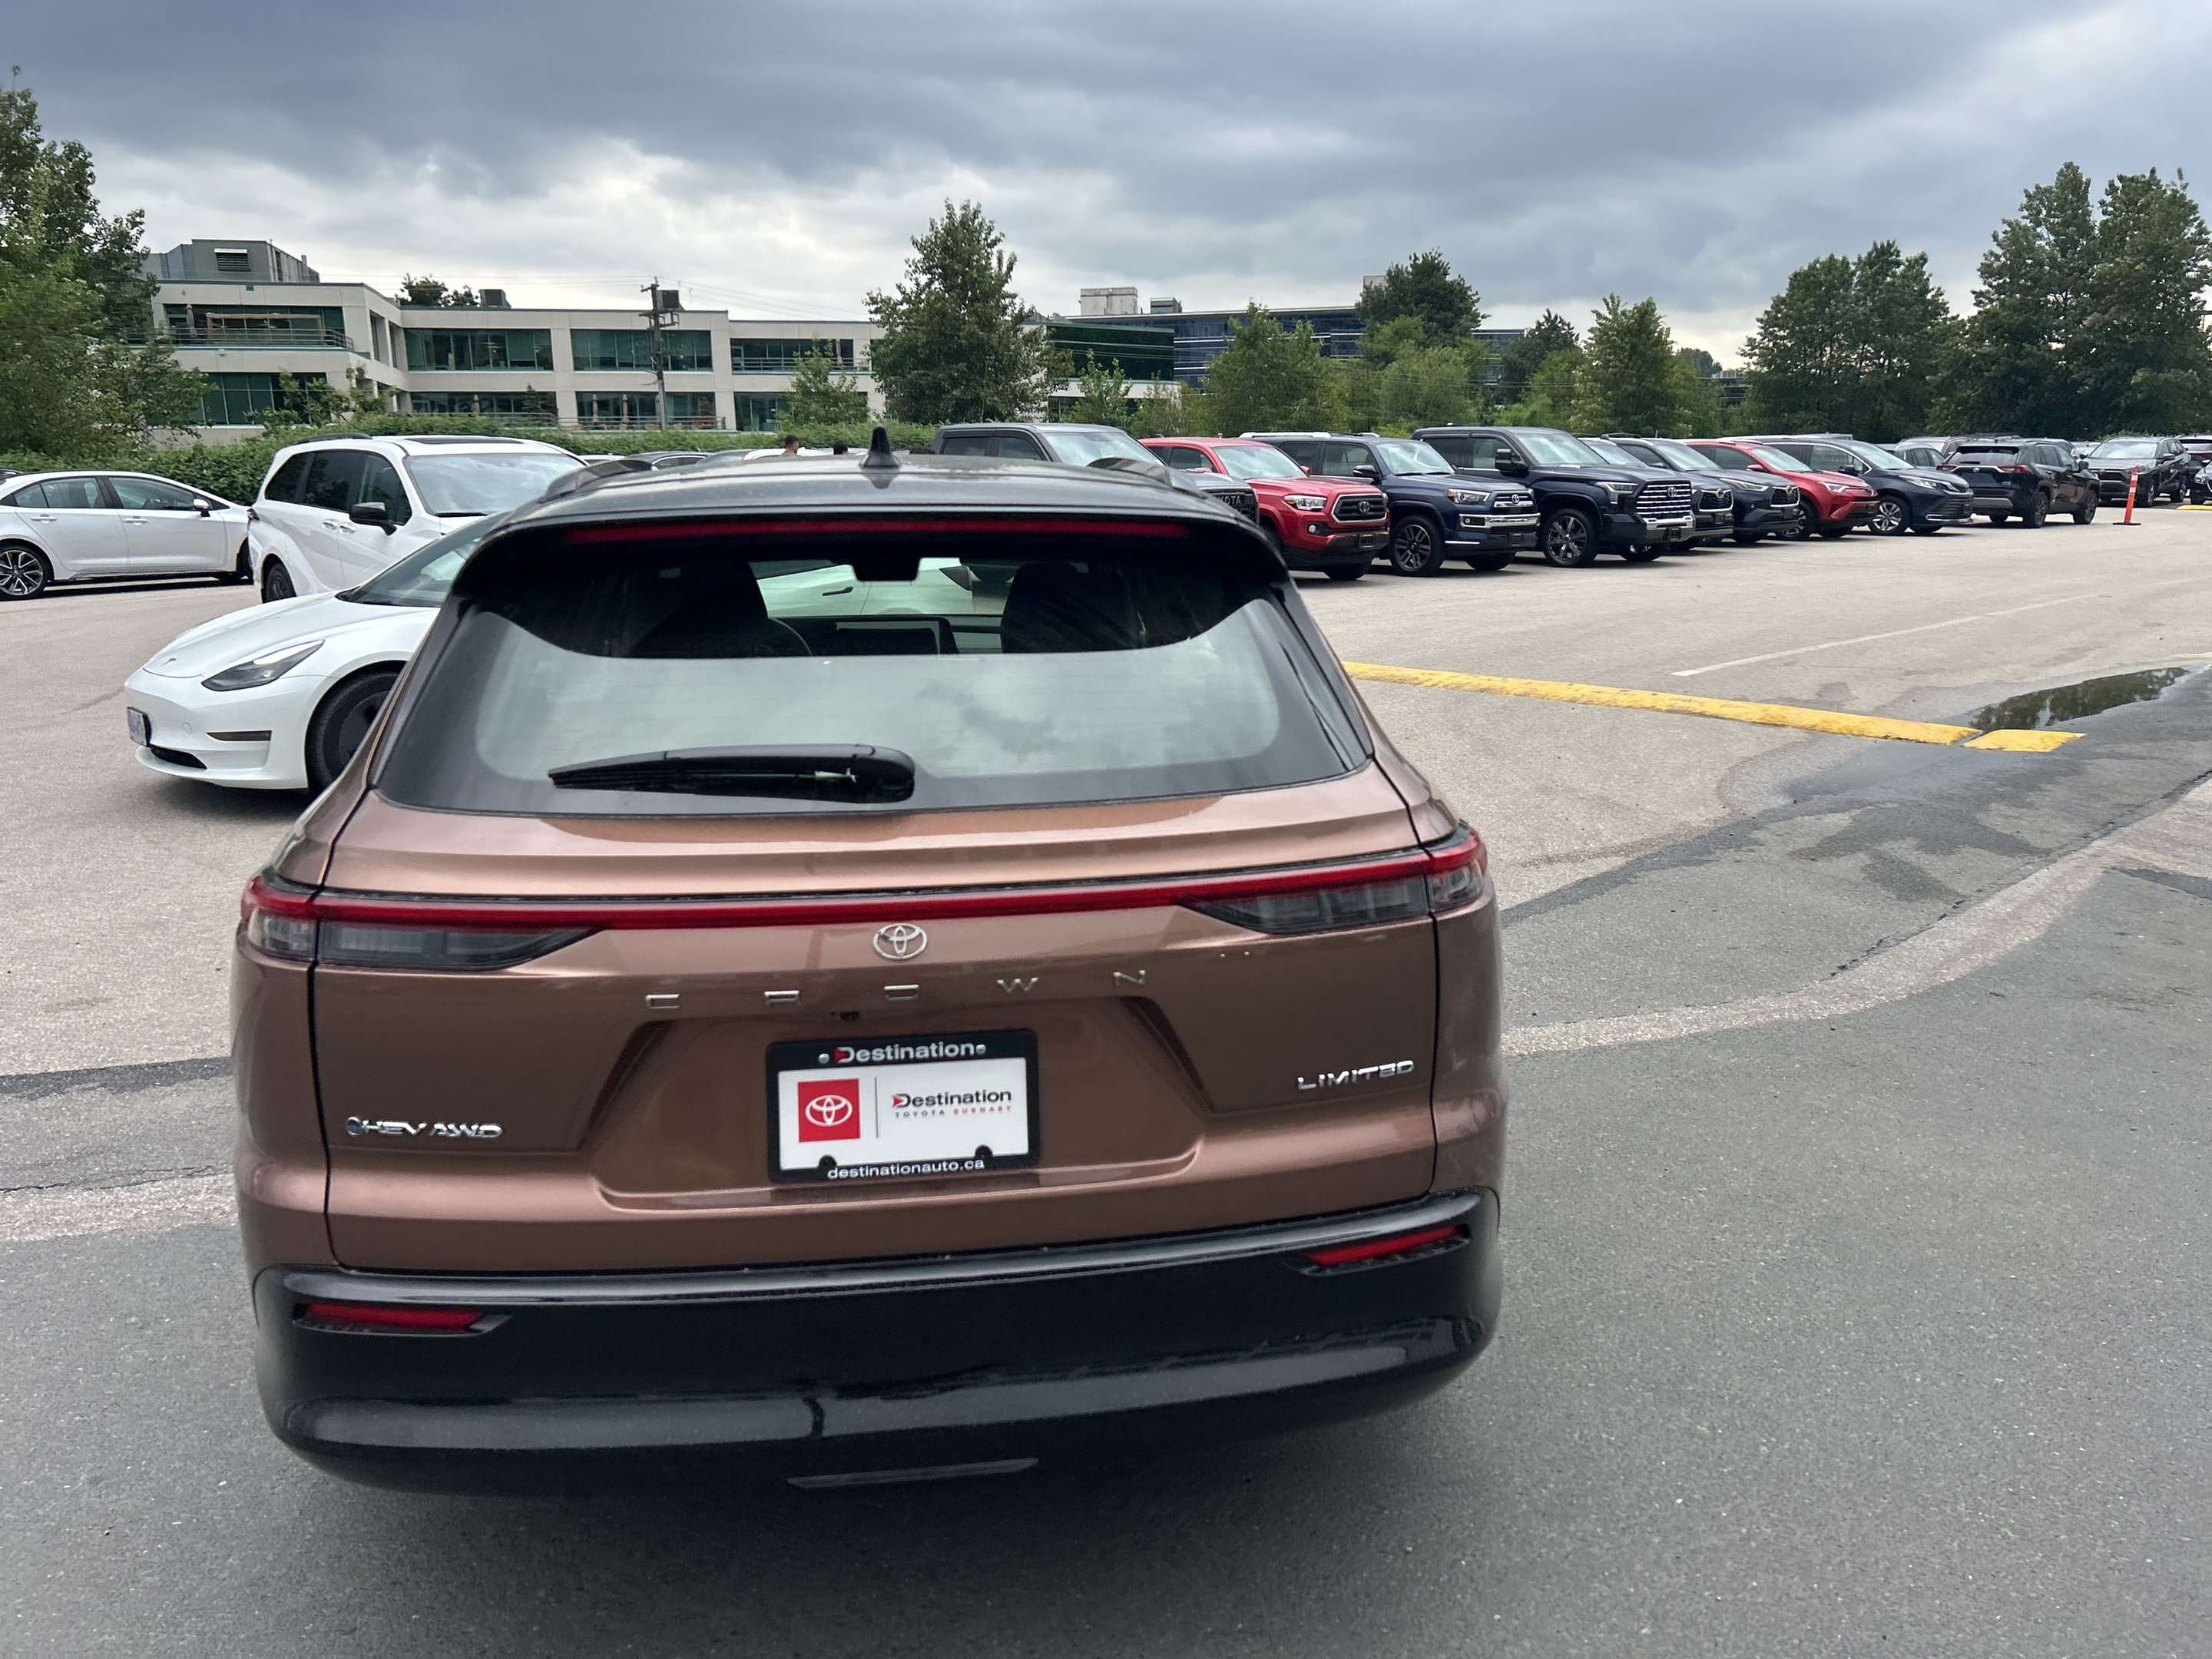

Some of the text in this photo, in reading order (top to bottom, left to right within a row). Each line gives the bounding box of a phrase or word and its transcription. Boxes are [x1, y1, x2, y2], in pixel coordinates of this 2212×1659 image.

[835, 1041, 975, 1064] Destination
[1297, 1060, 1414, 1089] LIMITED
[892, 1089, 1012, 1108] Destination
[895, 1105, 1012, 1118] TOYOTA BURNABY
[429, 1123, 504, 1137] AWD
[827, 1158, 985, 1180] destinationauto.ca
